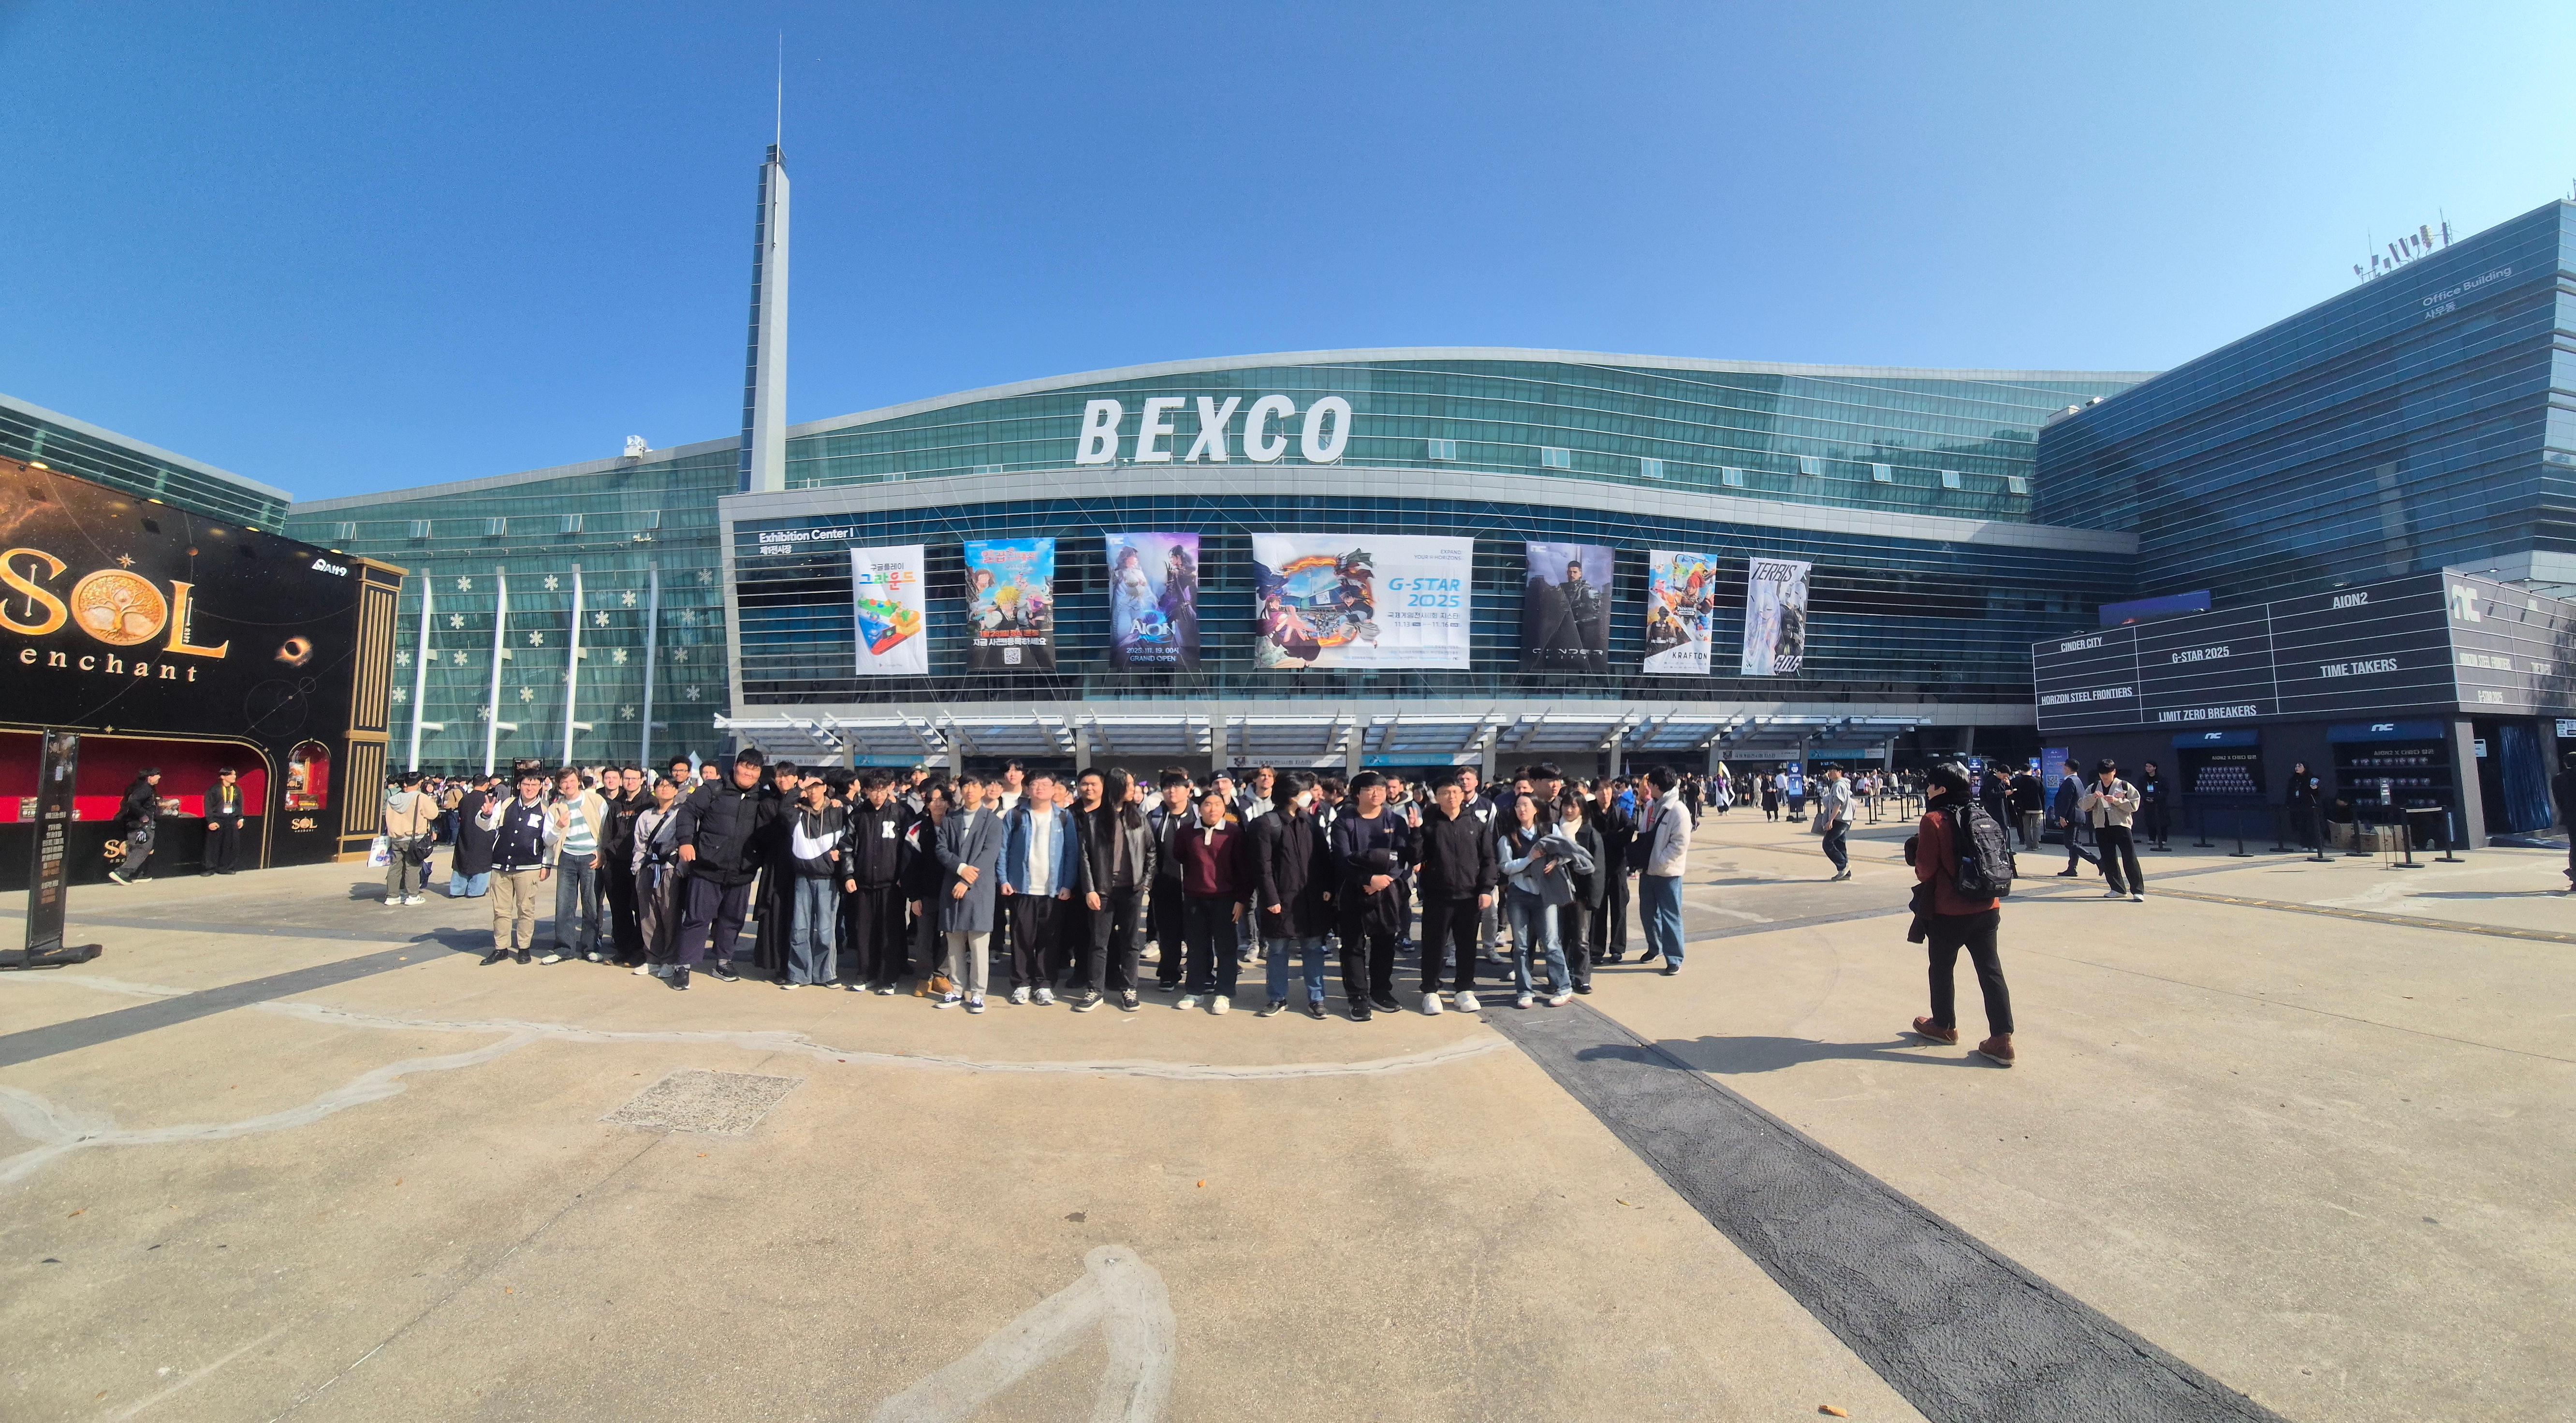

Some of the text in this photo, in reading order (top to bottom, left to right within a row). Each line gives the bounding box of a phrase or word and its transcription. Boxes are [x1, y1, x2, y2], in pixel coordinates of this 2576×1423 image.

[2422, 267, 2513, 306] Office Building
[2425, 301, 2457, 320] 사무동
[1075, 394, 1351, 464] BEXCO
[759, 531, 810, 543] Exhibition
[811, 529, 848, 540] Center
[760, 545, 792, 555] 제1전시장
[870, 562, 904, 571] 구글플레이
[1751, 562, 1798, 582] TERBIS
[859, 571, 916, 591] 그라운드
[1389, 578, 1460, 592] G-STAR
[0, 548, 229, 659] SOL
[1407, 594, 1461, 608] 2025
[2333, 592, 2369, 609] AION2
[1129, 619, 1176, 636] AION
[989, 638, 1047, 646] 사전등록하세요
[2061, 637, 2102, 652] CINDER CITY
[2172, 646, 2230, 663] G-STAR 2025
[19, 646, 198, 682] enchant
[2320, 658, 2398, 677] TIME TAKERS
[2041, 687, 2133, 705] HORIZON STEEL FRONTIERS
[2158, 705, 2257, 723] LIMIT ZERO BREAKERS
[292, 817, 318, 830] SOL
[527, 813, 542, 828] K
[882, 821, 896, 839] K
